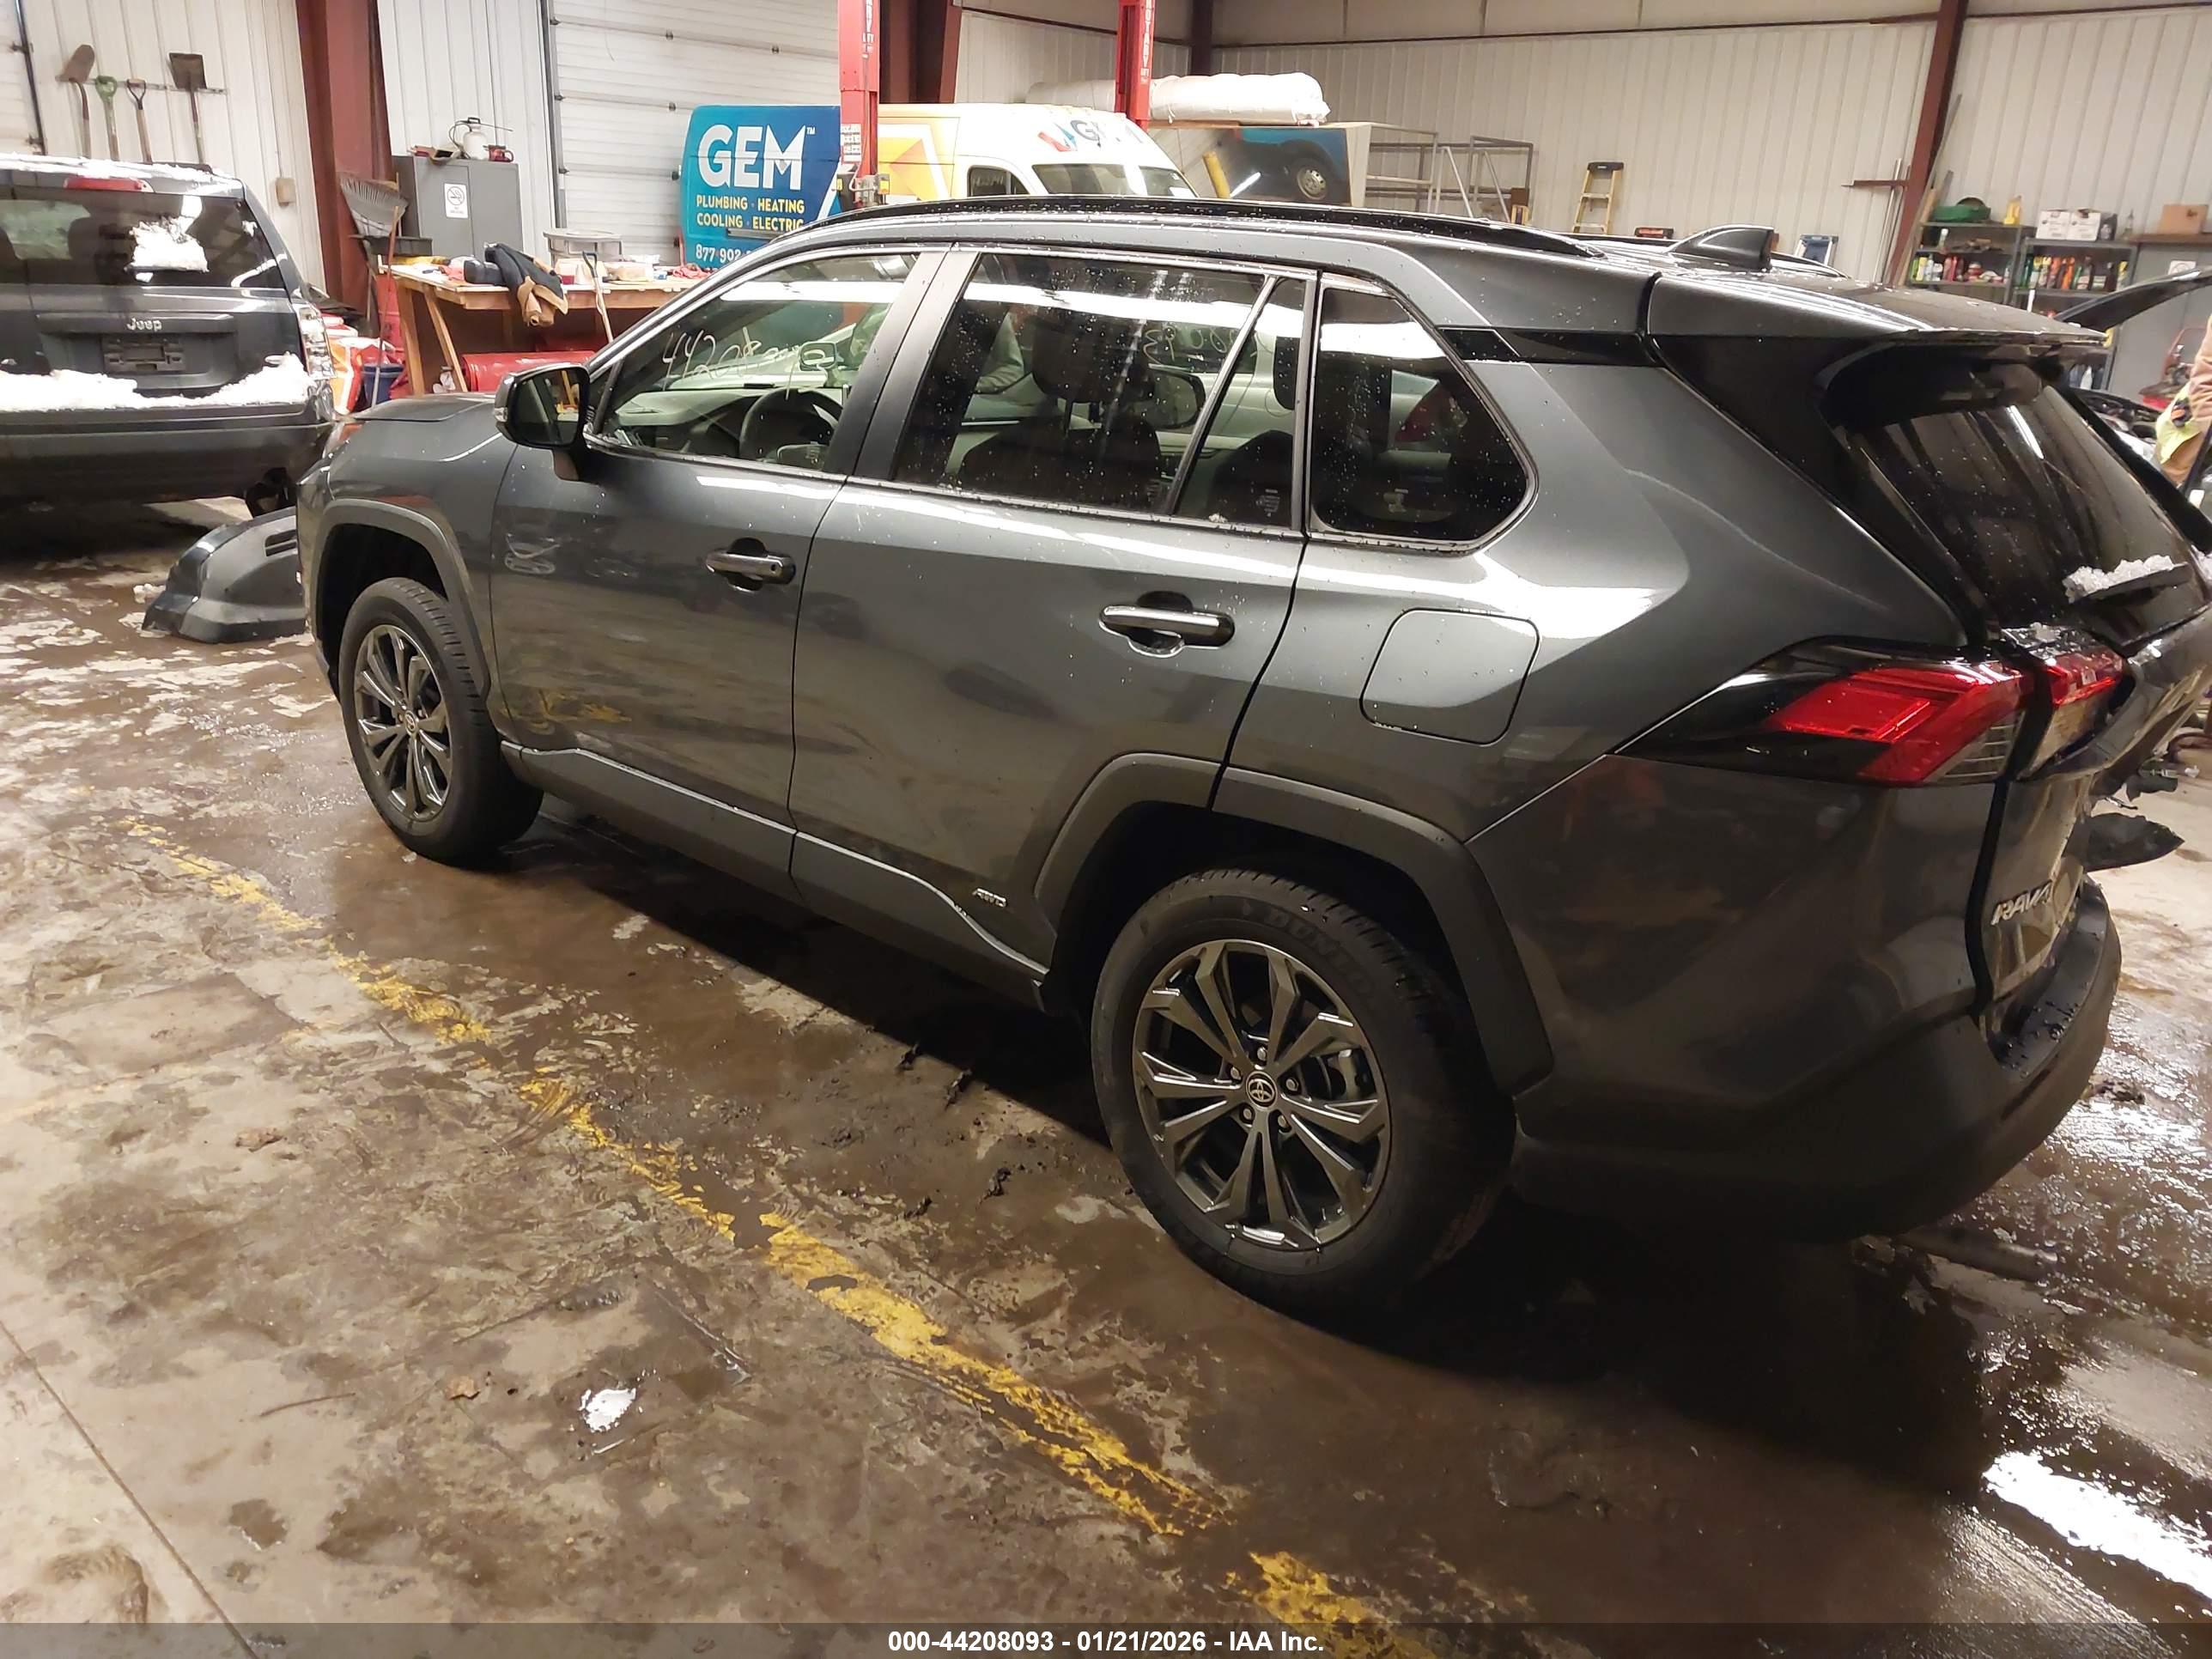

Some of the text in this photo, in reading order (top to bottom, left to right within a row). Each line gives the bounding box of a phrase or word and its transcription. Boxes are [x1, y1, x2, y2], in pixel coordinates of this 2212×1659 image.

[698, 124, 805, 191] GEM
[696, 195, 805, 214] PLUMBING HEATING
[696, 213, 743, 228] COOLING
[126, 317, 162, 332] Jeep
